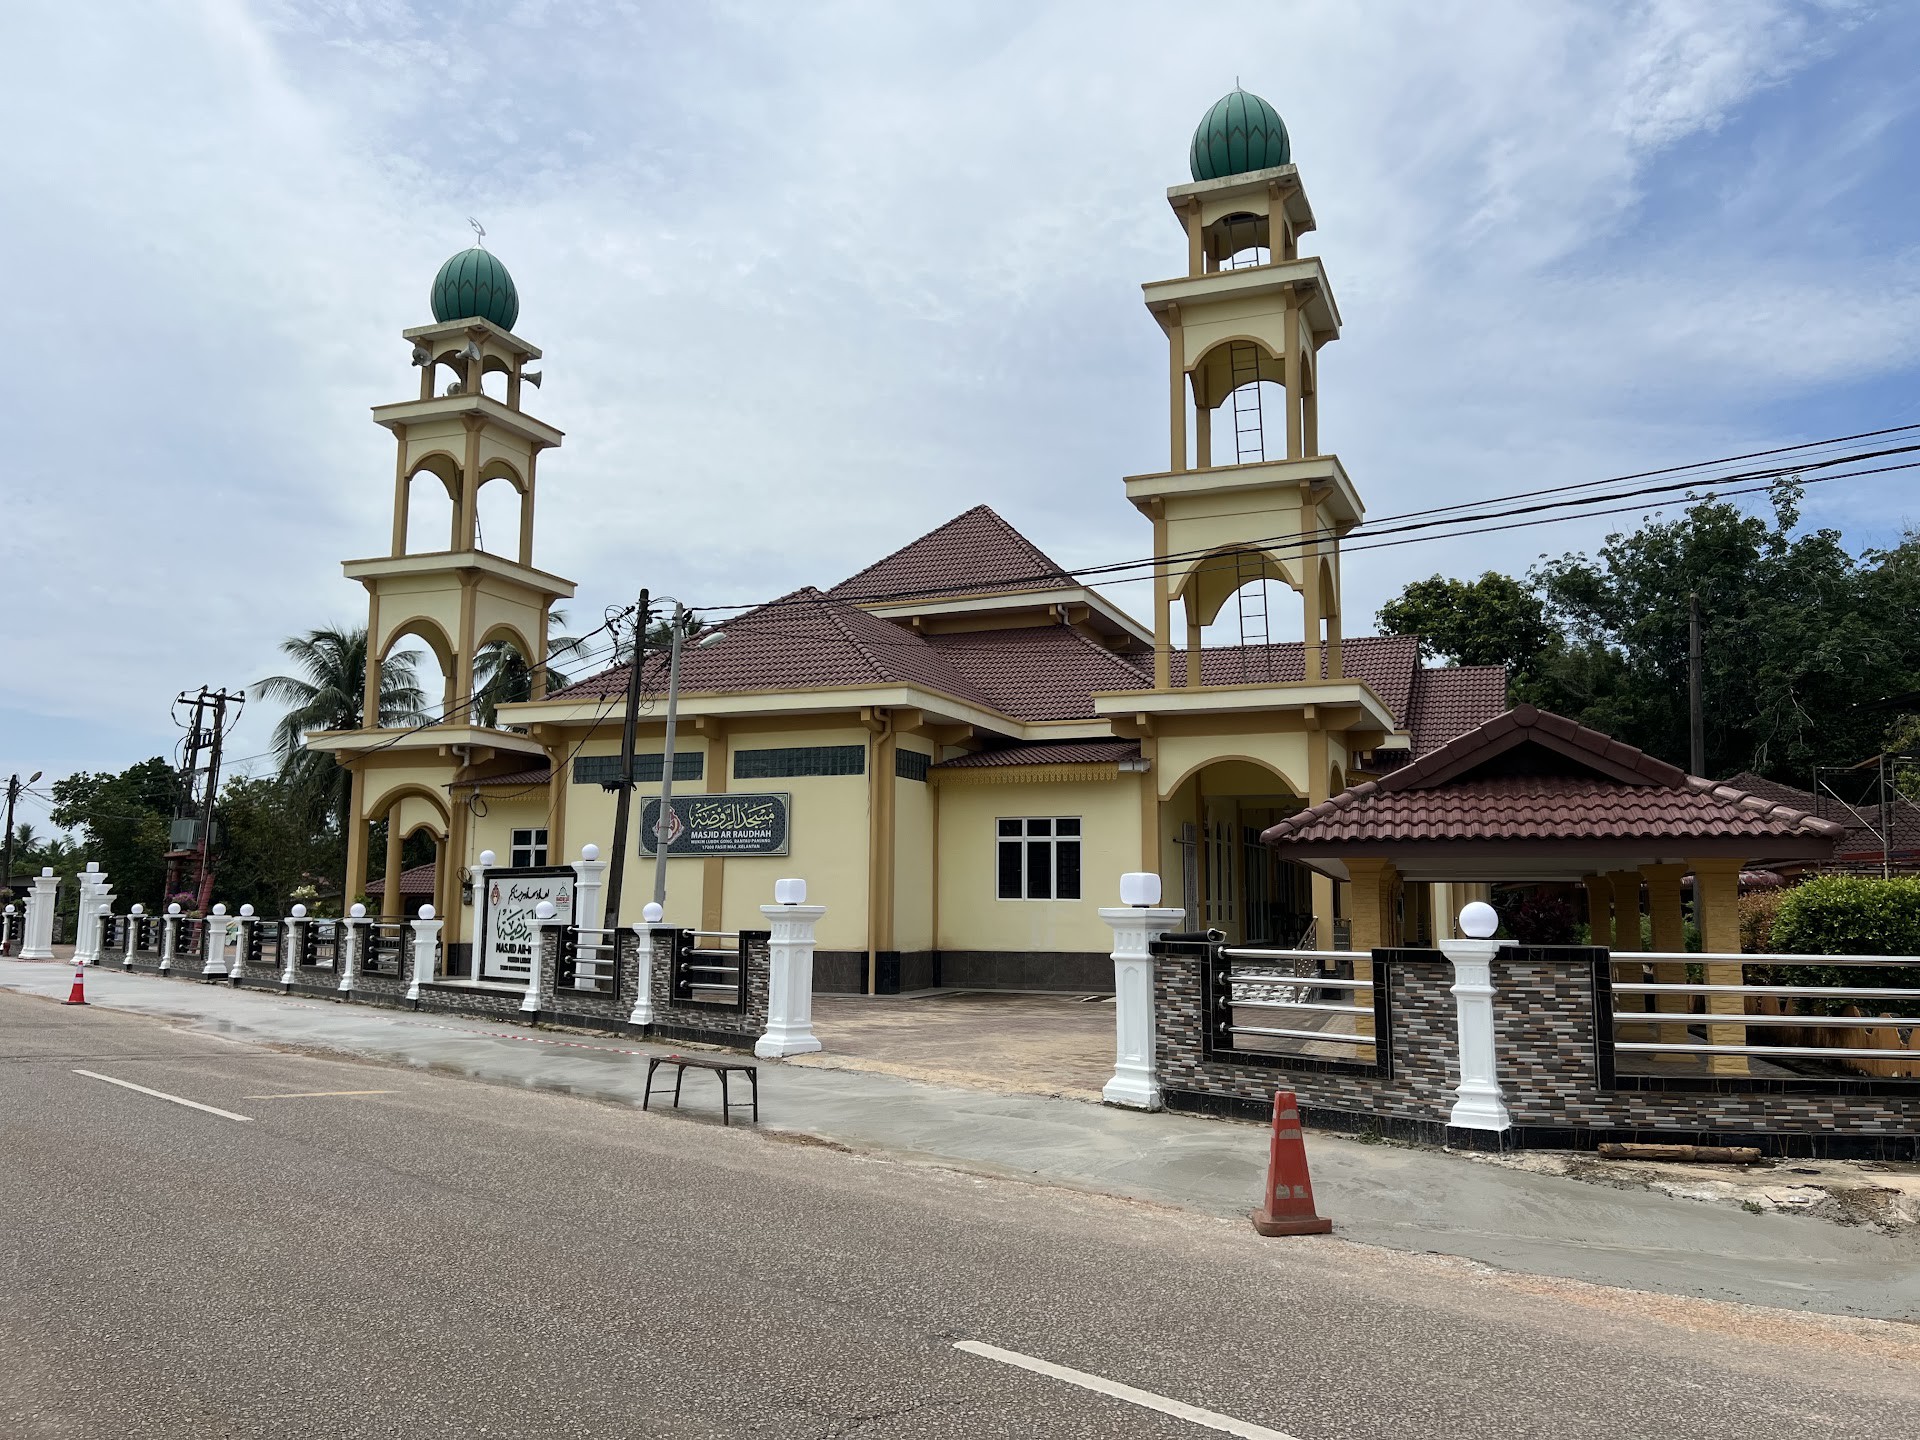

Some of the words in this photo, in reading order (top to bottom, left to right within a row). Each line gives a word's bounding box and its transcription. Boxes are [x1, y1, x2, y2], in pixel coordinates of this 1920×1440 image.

[691, 831, 719, 839] MASJID
[720, 830, 731, 838] AR
[732, 830, 772, 838] RAUDHAH
[496, 942, 517, 954] MASJID
